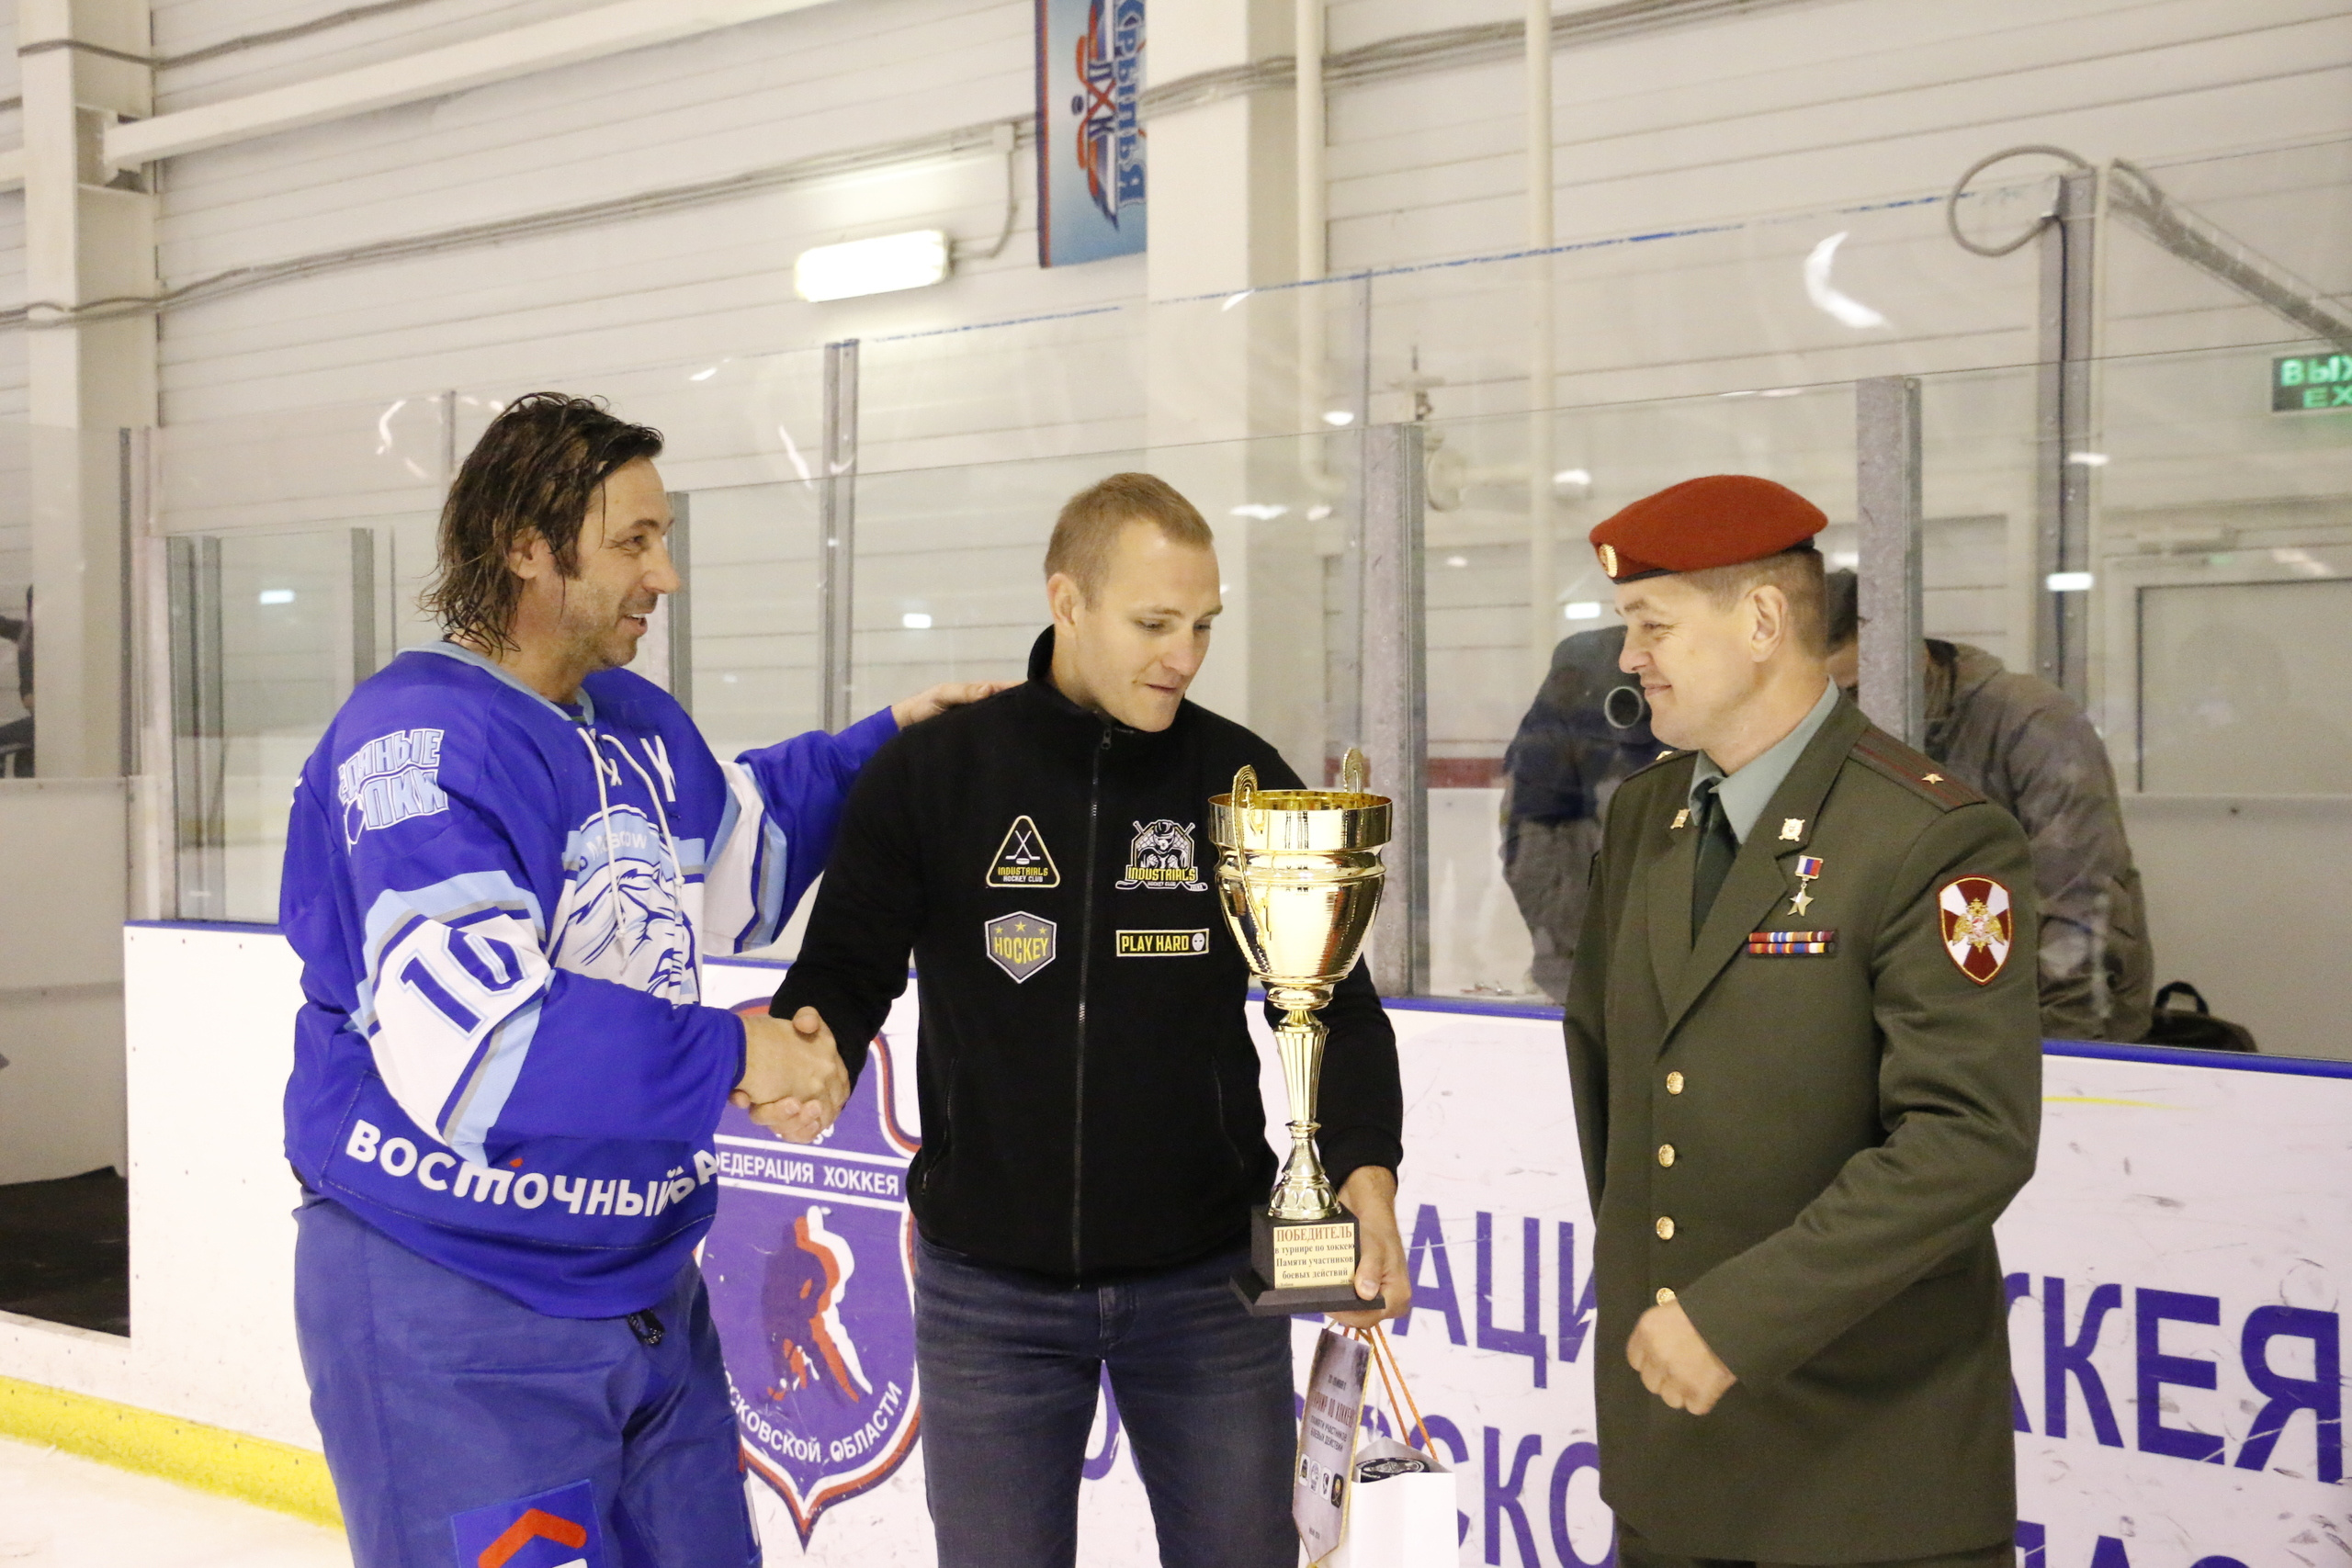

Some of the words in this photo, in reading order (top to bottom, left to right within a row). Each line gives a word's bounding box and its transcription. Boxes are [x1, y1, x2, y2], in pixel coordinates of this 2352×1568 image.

[998, 867, 1048, 876] INDUSTRIALS
[1128, 867, 1195, 881] INDUSTRIALS
[993, 936, 1049, 964] HOCKEY
[1122, 935, 1153, 952] PLAY
[1156, 935, 1189, 952] HARD
[397, 927, 529, 1040] 10
[823, 1166, 899, 1197] ХОККЕЯ
[1276, 1225, 1352, 1243] ПОБЕДИТЕЛЬ
[1282, 1246, 1313, 1256] турнире
[1327, 1243, 1355, 1251] хоккею
[1276, 1258, 1307, 1267] Памяти
[1309, 1256, 1354, 1268] участников
[1283, 1270, 1310, 1280] боевых
[1312, 1268, 1348, 1278] действий
[830, 1381, 903, 1462] ОБЛАСТИ
